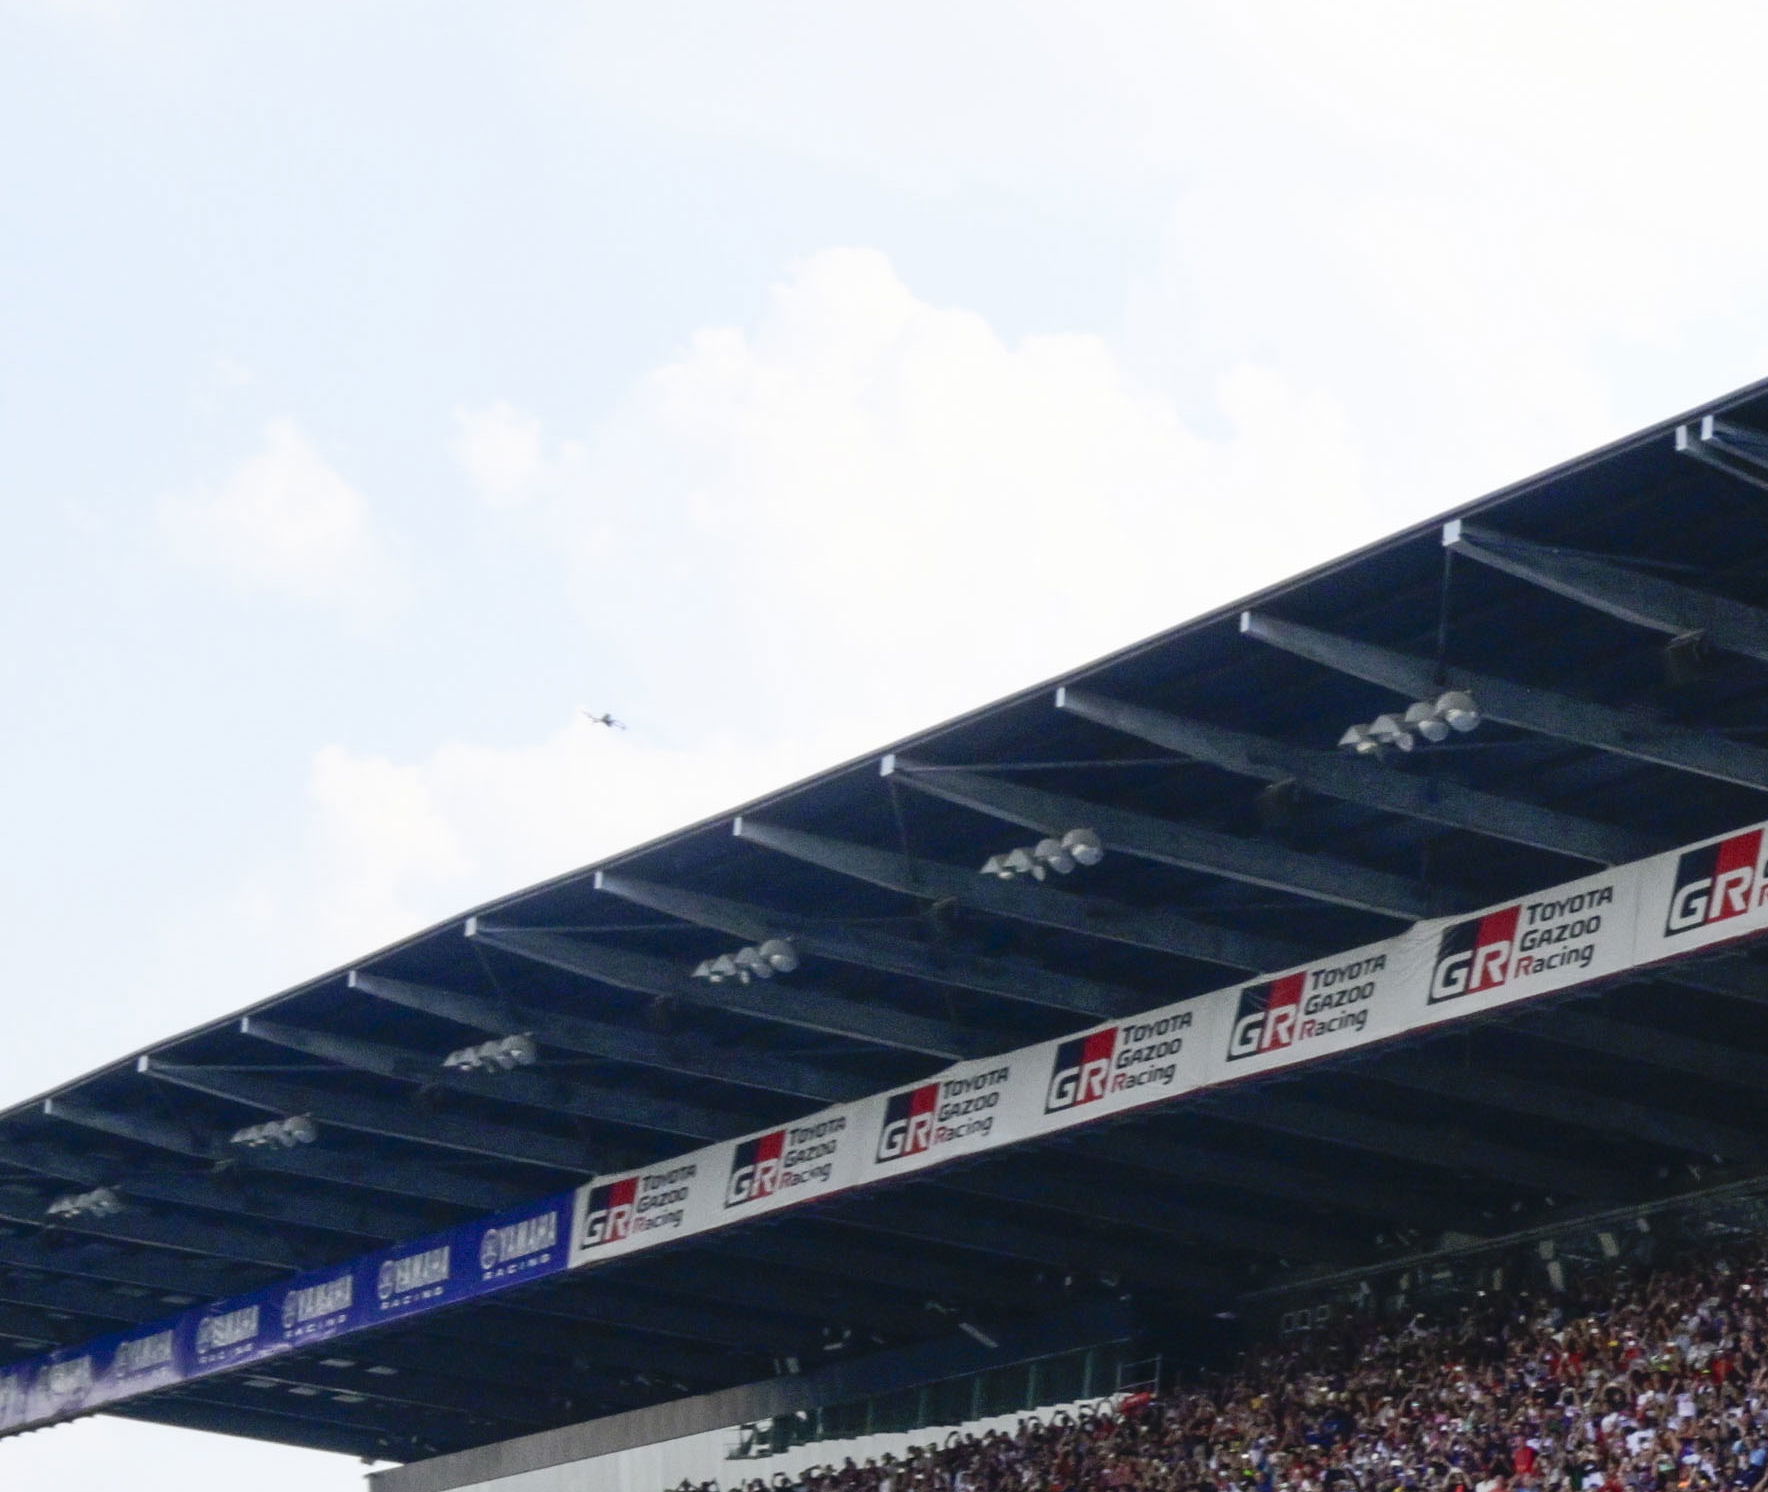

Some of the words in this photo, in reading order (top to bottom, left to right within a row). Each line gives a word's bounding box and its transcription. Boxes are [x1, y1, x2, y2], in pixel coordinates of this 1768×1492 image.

[1527, 886, 1613, 925] TOYOTA
[1663, 866, 1756, 937] GR
[1520, 916, 1601, 951] GAZOO
[1311, 954, 1386, 990] TOYOTA
[1426, 940, 1514, 1005] GR
[1514, 944, 1595, 979] Racing
[1304, 982, 1375, 1015] GAZOO
[1123, 1012, 1192, 1044] TOYOTA
[1226, 1004, 1297, 1062] GR
[1300, 1010, 1368, 1040] Racing
[1116, 1039, 1183, 1069] GAZOO
[943, 1066, 1009, 1098] TOYOTA
[1111, 1065, 1177, 1093] Racing
[938, 1093, 999, 1121] GAZOO
